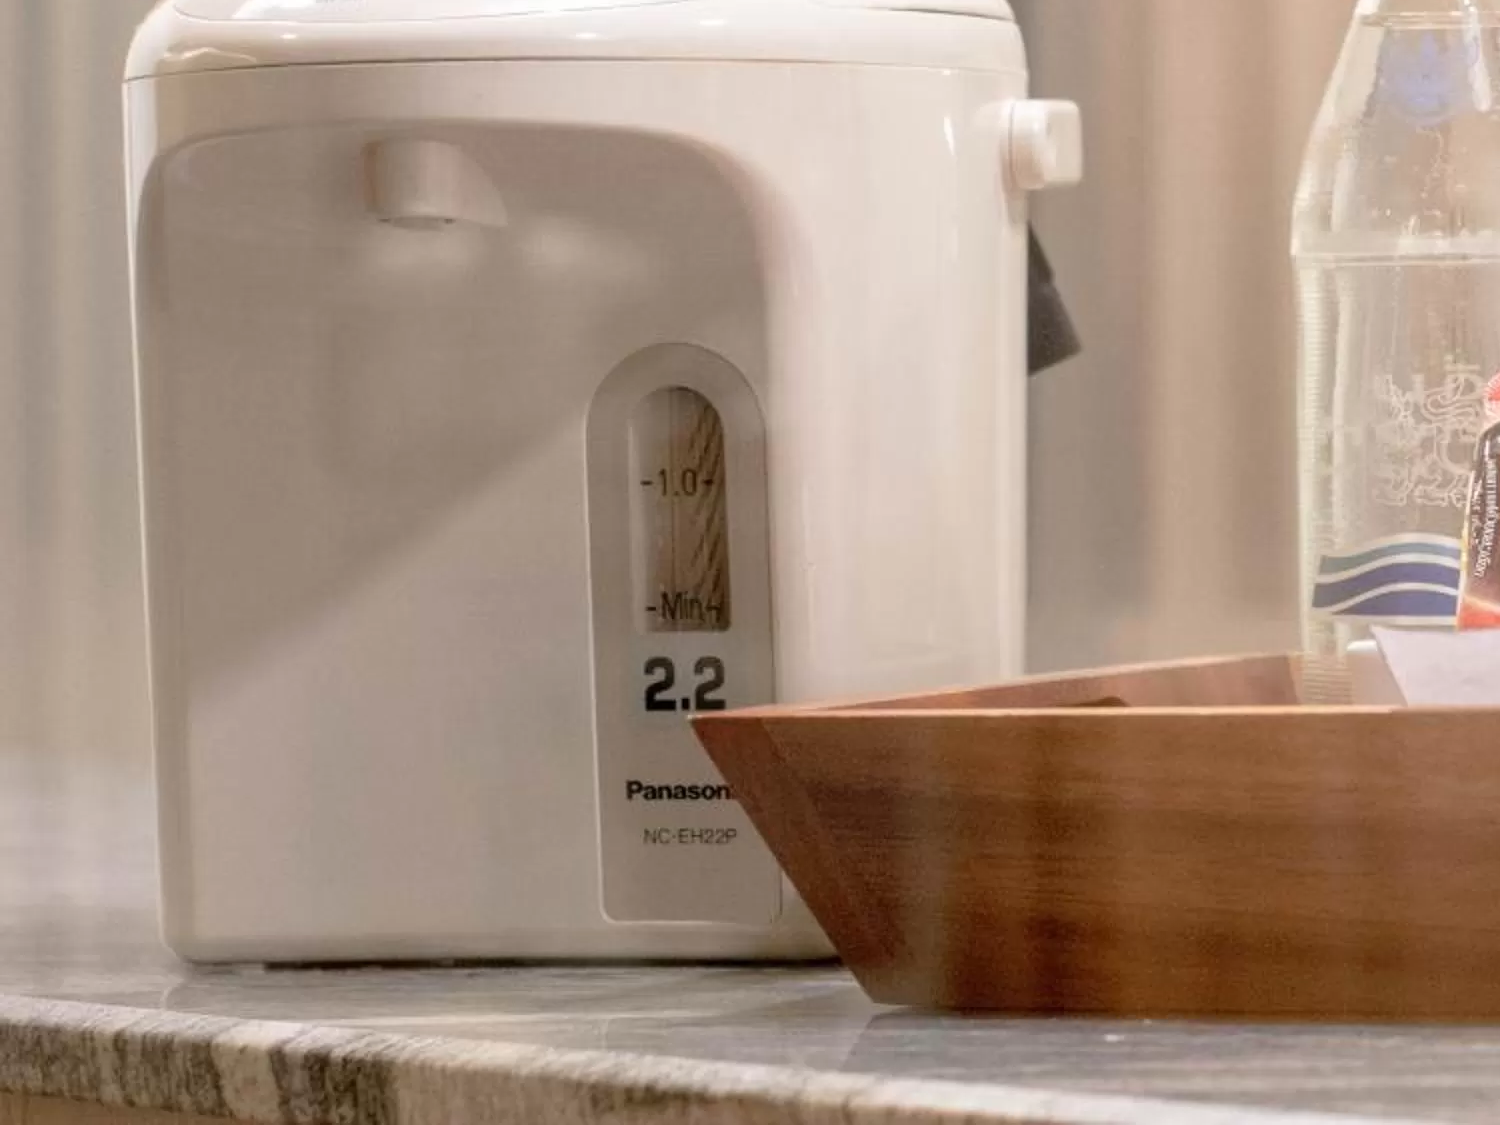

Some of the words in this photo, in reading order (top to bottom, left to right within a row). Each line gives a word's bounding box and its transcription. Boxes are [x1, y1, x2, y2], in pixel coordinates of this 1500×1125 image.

[644, 656, 726, 711] 2.2
[626, 779, 732, 801] Panason
[643, 827, 737, 844] NC-EH22P
